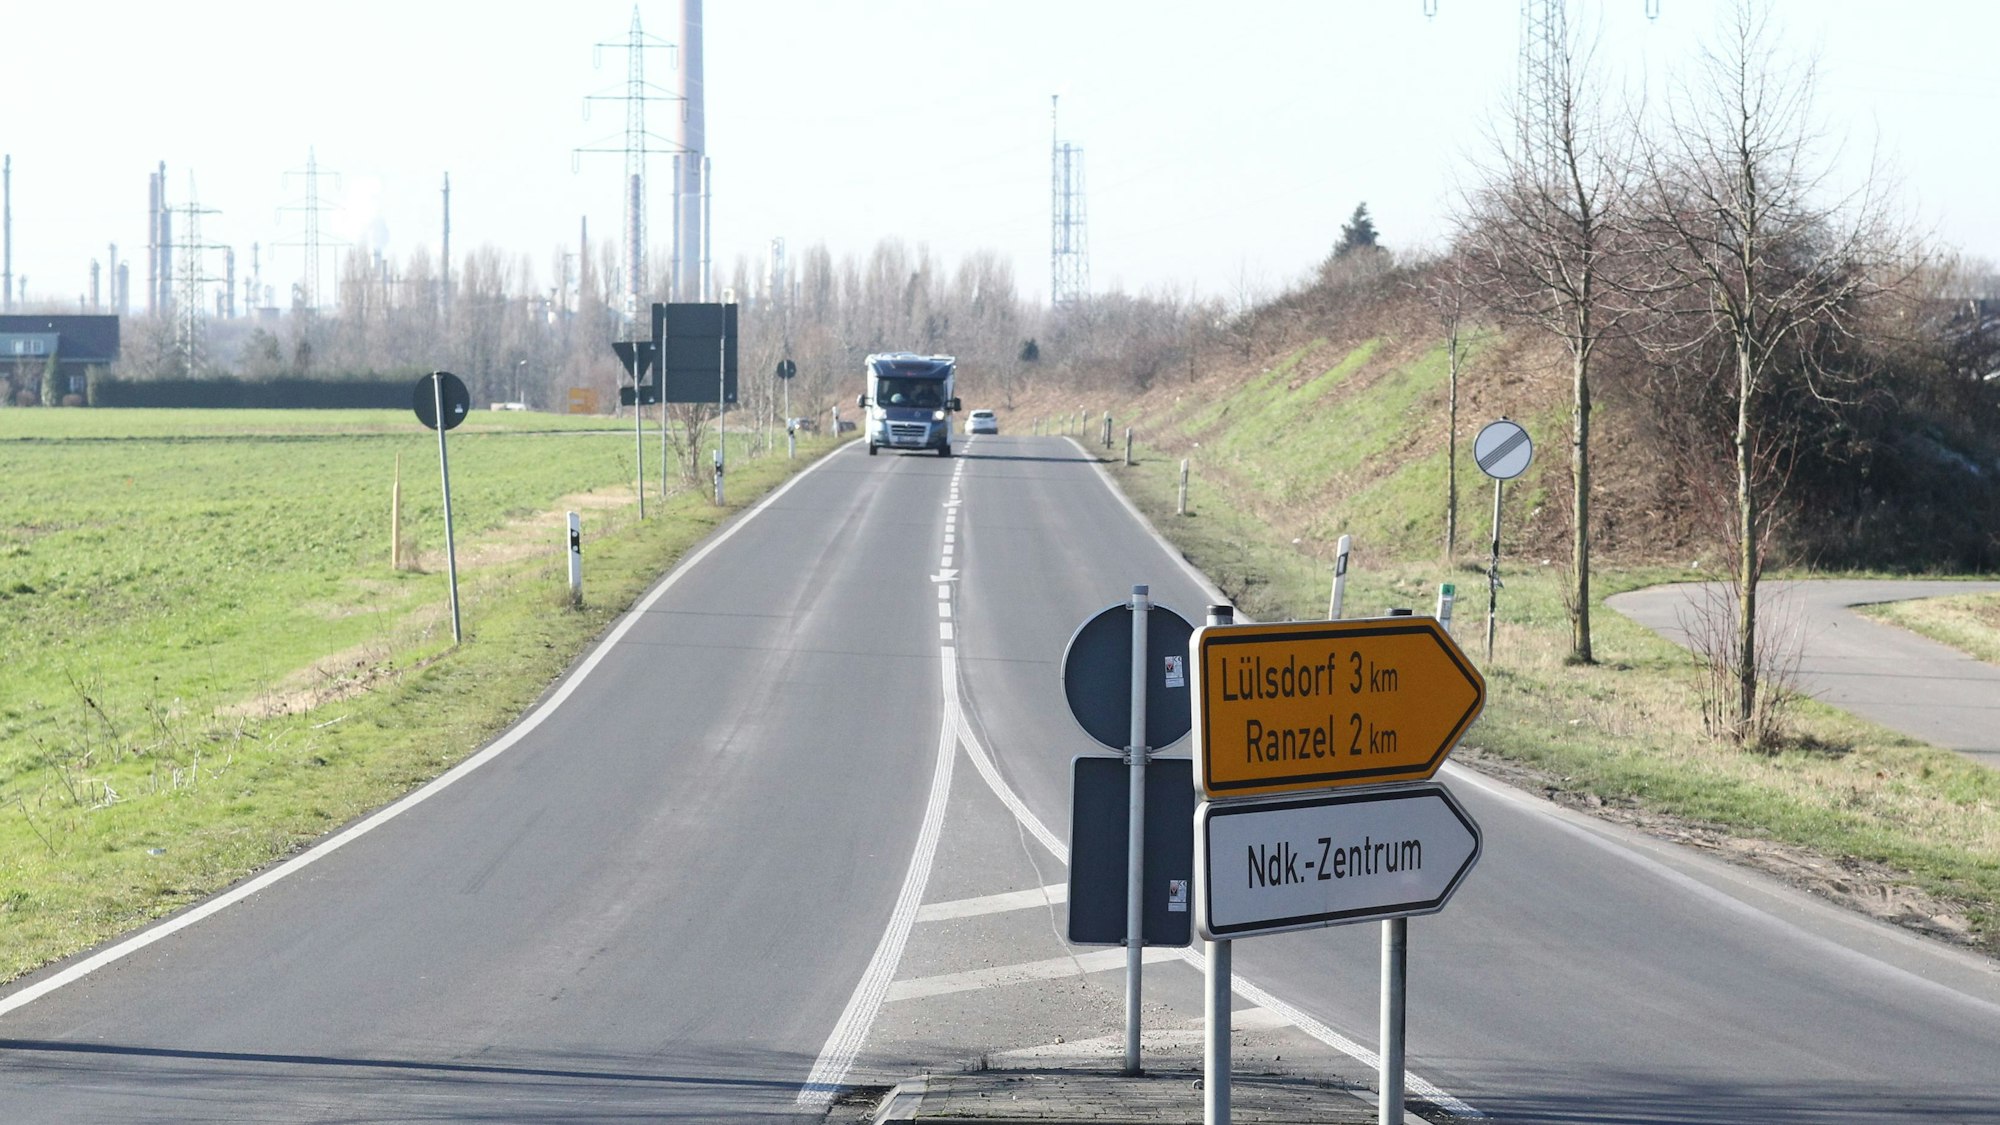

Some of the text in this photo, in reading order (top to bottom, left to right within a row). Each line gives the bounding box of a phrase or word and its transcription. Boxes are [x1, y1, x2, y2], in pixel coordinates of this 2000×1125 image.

[1222, 654, 1336, 701] Lülsdorf
[1349, 651, 1363, 694] 3
[1370, 661, 1398, 693] km
[1246, 713, 1398, 763] Ranzel 2 km
[1247, 836, 1422, 889] Ndk.-Zentrum
